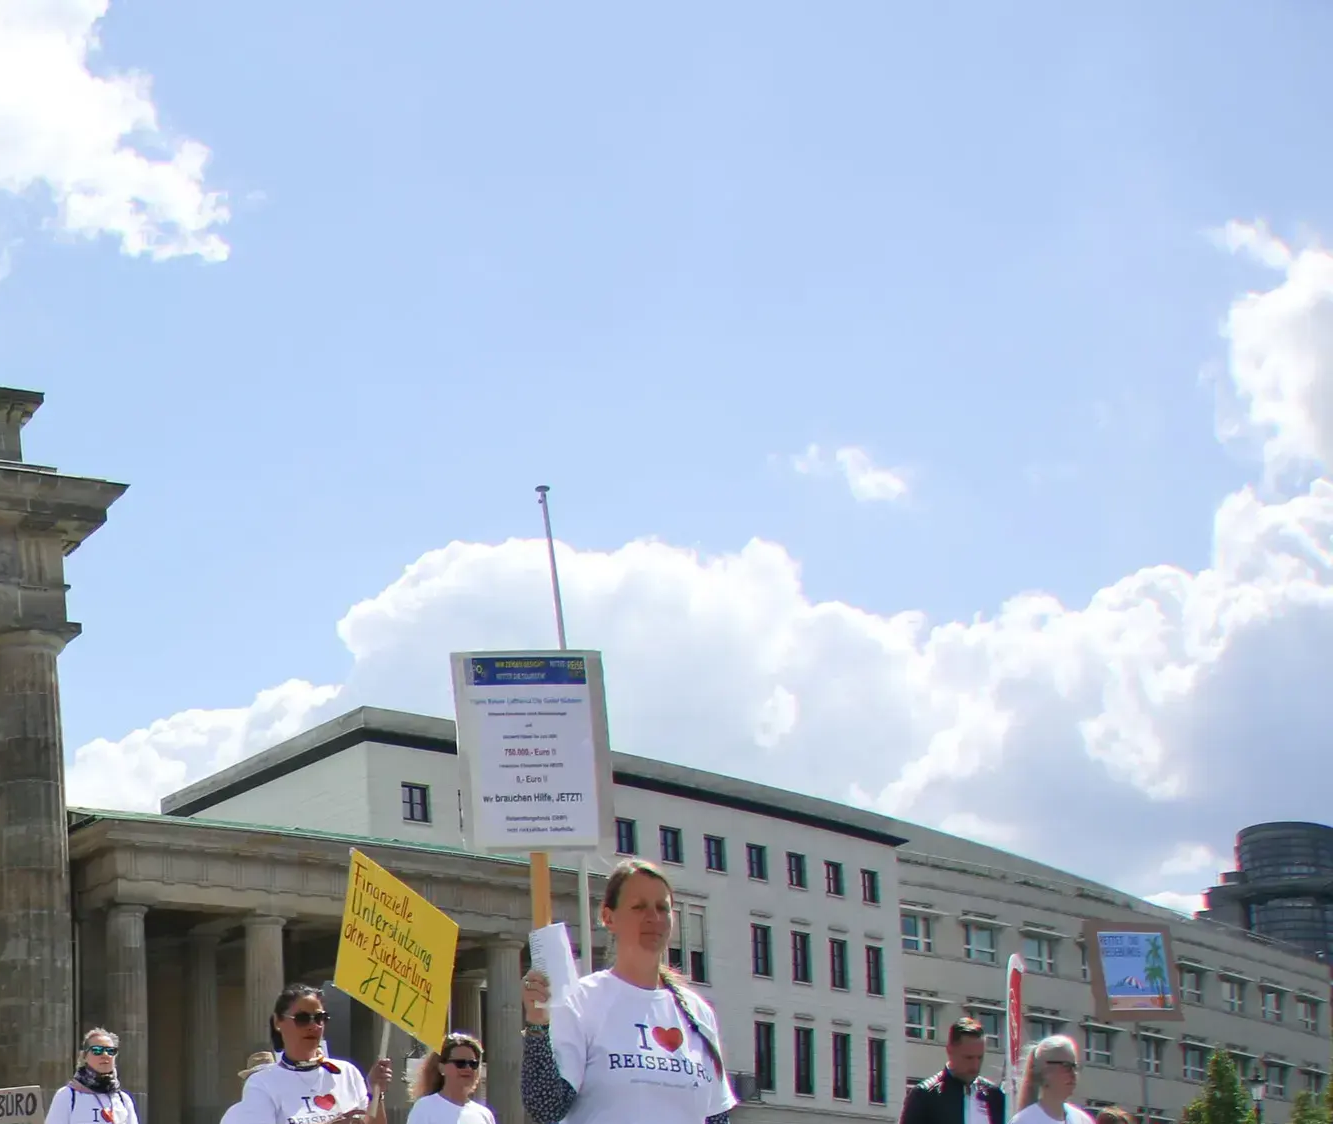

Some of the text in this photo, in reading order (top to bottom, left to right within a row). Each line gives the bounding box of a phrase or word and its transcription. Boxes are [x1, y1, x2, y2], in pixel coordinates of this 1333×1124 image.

[534, 748, 550, 756] Euro
[526, 775, 542, 783] Euro
[495, 793, 533, 803] brauchen
[534, 793, 555, 803] Hilfe,
[556, 792, 583, 803] JETZT!
[354, 861, 414, 925] Finanzielle
[344, 920, 369, 952] ohne
[370, 933, 433, 998] Rückzahlung
[359, 957, 435, 1033] JETZT
[634, 1023, 654, 1051] I
[92, 1108, 100, 1123] I
[301, 1096, 312, 1114] I
